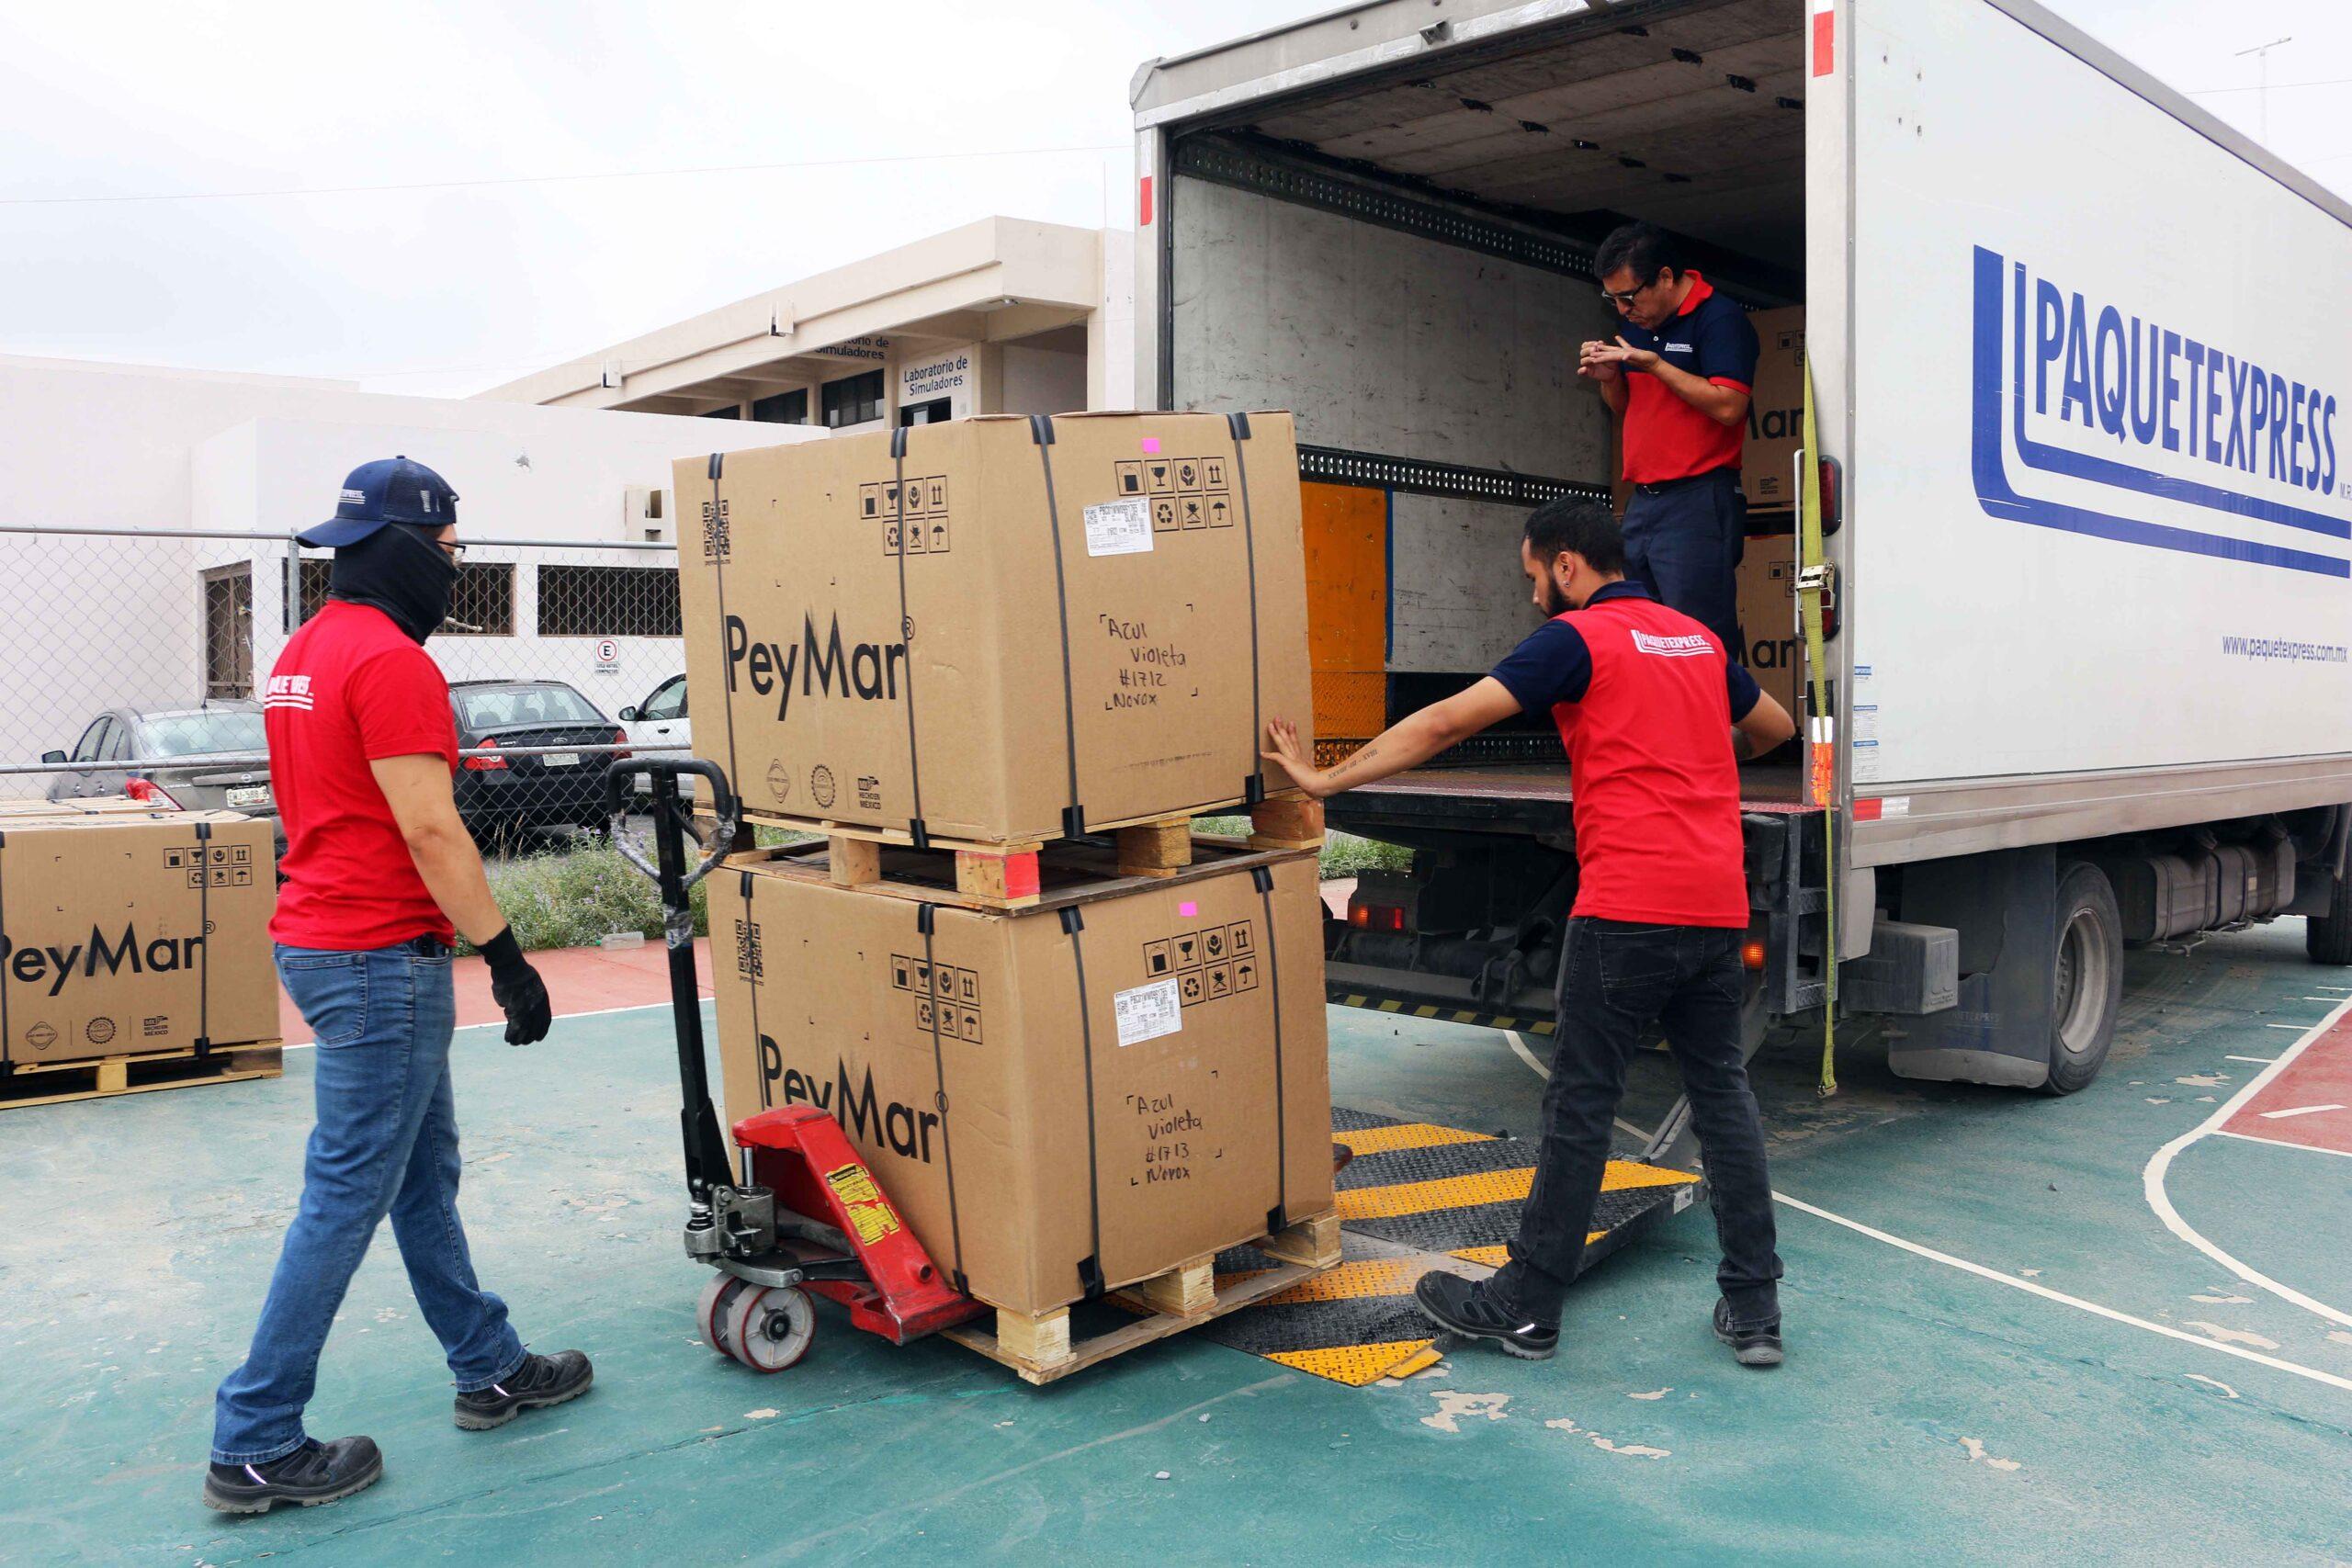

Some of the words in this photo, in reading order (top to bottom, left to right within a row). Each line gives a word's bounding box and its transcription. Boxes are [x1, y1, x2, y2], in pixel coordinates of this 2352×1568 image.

[904, 359, 954, 383] Laboratorio
[956, 355, 967, 370] de
[909, 374, 964, 397] Simuladores
[2035, 276, 2336, 496] PAQUETEXPRESS
[604, 645, 611, 656] E
[2222, 635, 2347, 663] www.paquetexpress.com.mx
